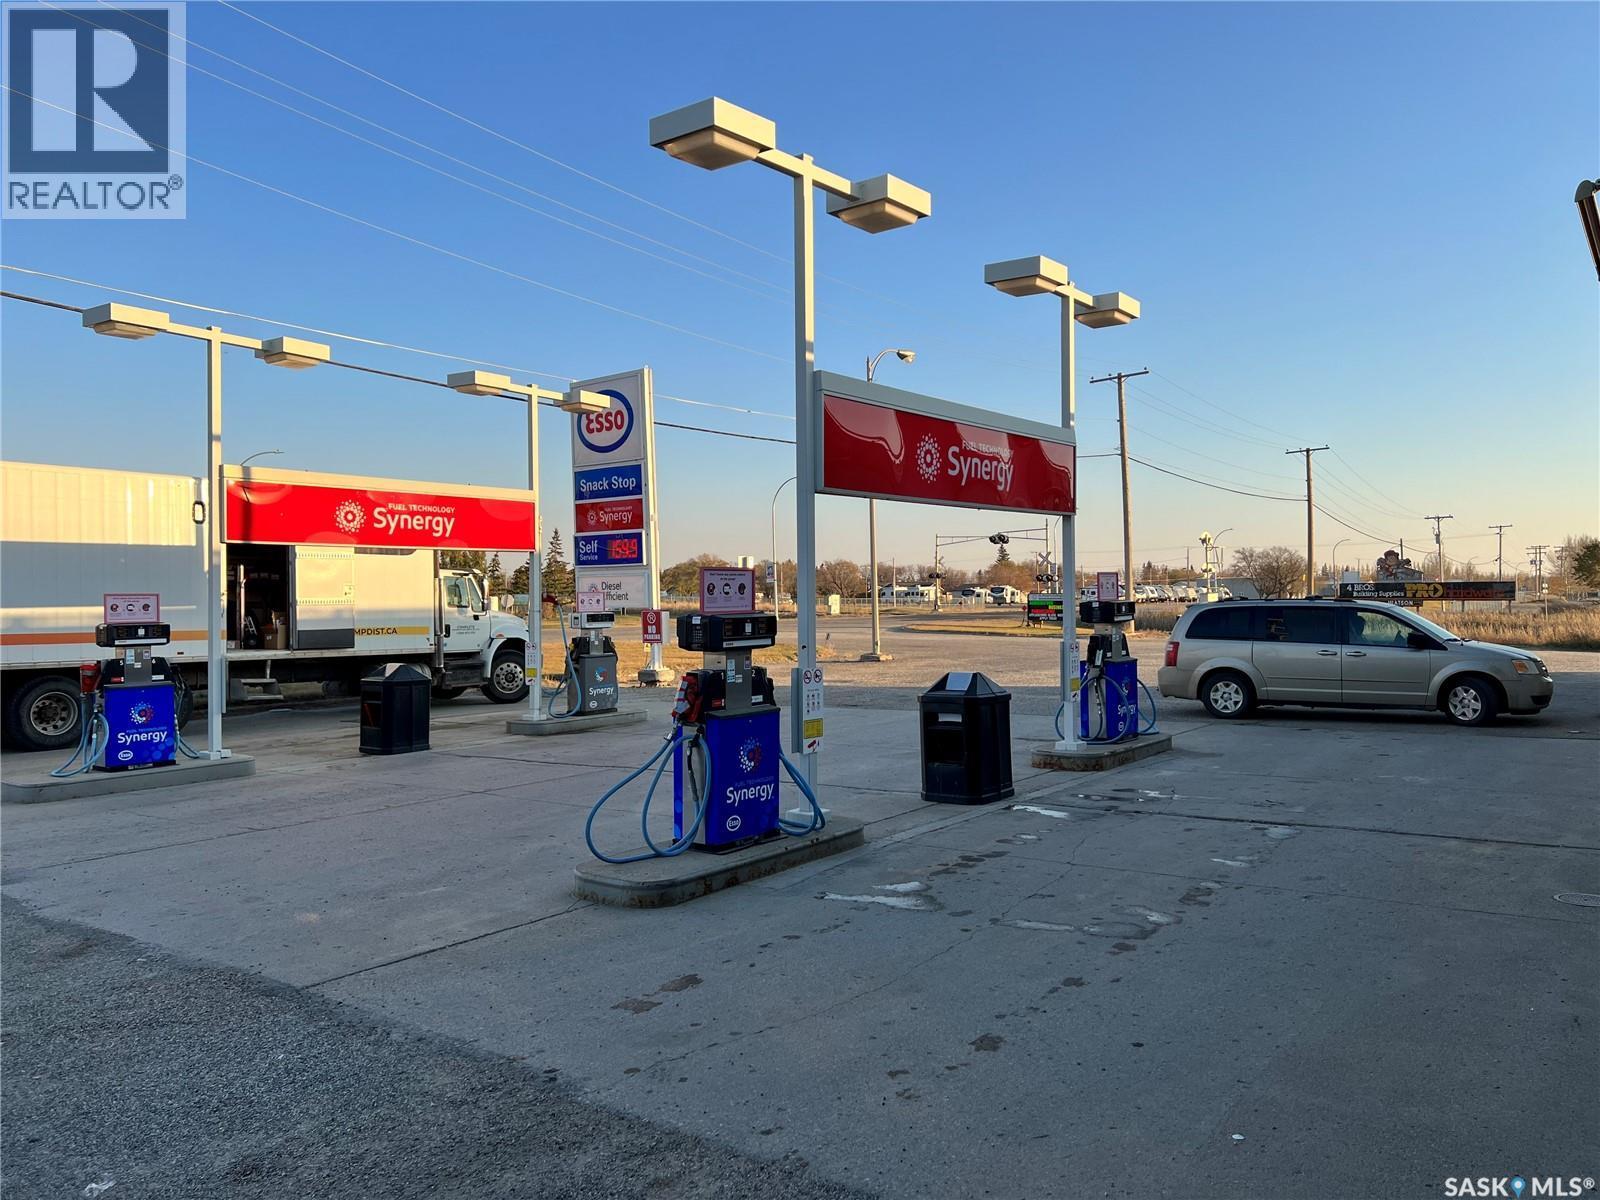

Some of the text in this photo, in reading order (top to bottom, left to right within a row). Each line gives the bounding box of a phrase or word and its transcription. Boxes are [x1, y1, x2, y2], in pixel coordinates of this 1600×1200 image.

[947, 445, 1014, 493] Synergy
[580, 475, 636, 492] Snack Stop
[387, 502, 456, 514] FUEL TECHNOLOGY
[373, 507, 456, 538] Synergy
[600, 511, 633, 524] Synergy
[579, 540, 598, 553] Self
[579, 553, 599, 561] Service
[601, 581, 622, 590] Diesel
[1404, 583, 1444, 598] PRO
[605, 592, 629, 601] fficient
[647, 625, 656, 634] NO
[589, 687, 614, 696] Synergy
[117, 731, 168, 745] Synergy
[726, 783, 774, 807] Synergy
